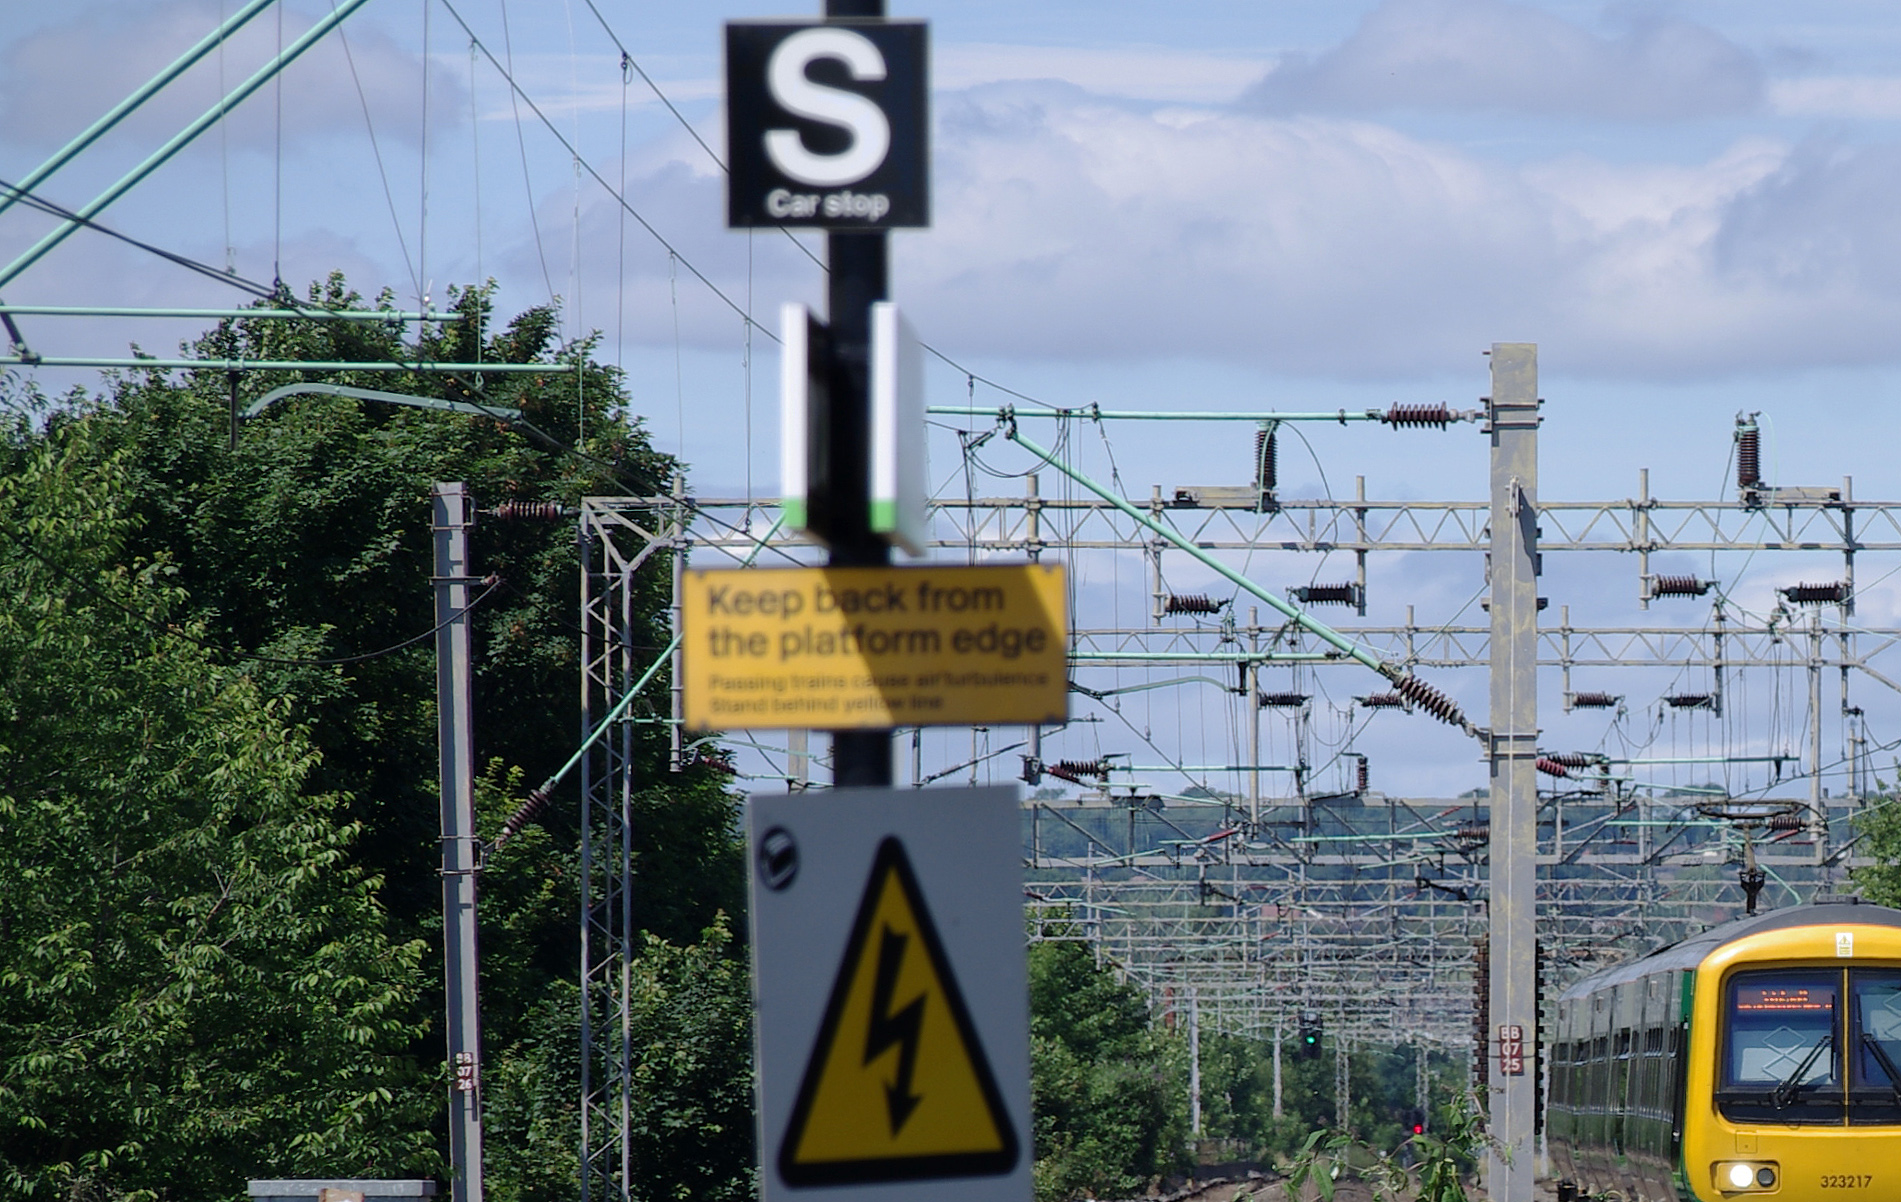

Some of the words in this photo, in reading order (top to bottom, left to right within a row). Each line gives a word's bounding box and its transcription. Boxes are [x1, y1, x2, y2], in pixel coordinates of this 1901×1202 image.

[764, 27, 891, 187] S
[767, 189, 821, 219] Car
[824, 189, 890, 222] stop
[707, 584, 803, 618] Keep
[815, 584, 906, 613] back
[917, 583, 1004, 613] from
[708, 627, 768, 657] the
[779, 624, 941, 661] platform
[951, 625, 1046, 659] edge
[709, 673, 786, 693] Passing
[791, 673, 847, 690] trains
[850, 674, 910, 688] cause
[945, 671, 1049, 686] turbulence
[709, 696, 766, 714] Stand
[772, 695, 838, 713] behind
[844, 695, 904, 714] yellow
[911, 694, 944, 709] line
[1501, 1026, 1520, 1040] BB
[1501, 1042, 1520, 1056] 07
[1502, 1058, 1521, 1071] 25
[457, 1079, 473, 1090] 26
[1820, 1175, 1873, 1188] 323217
